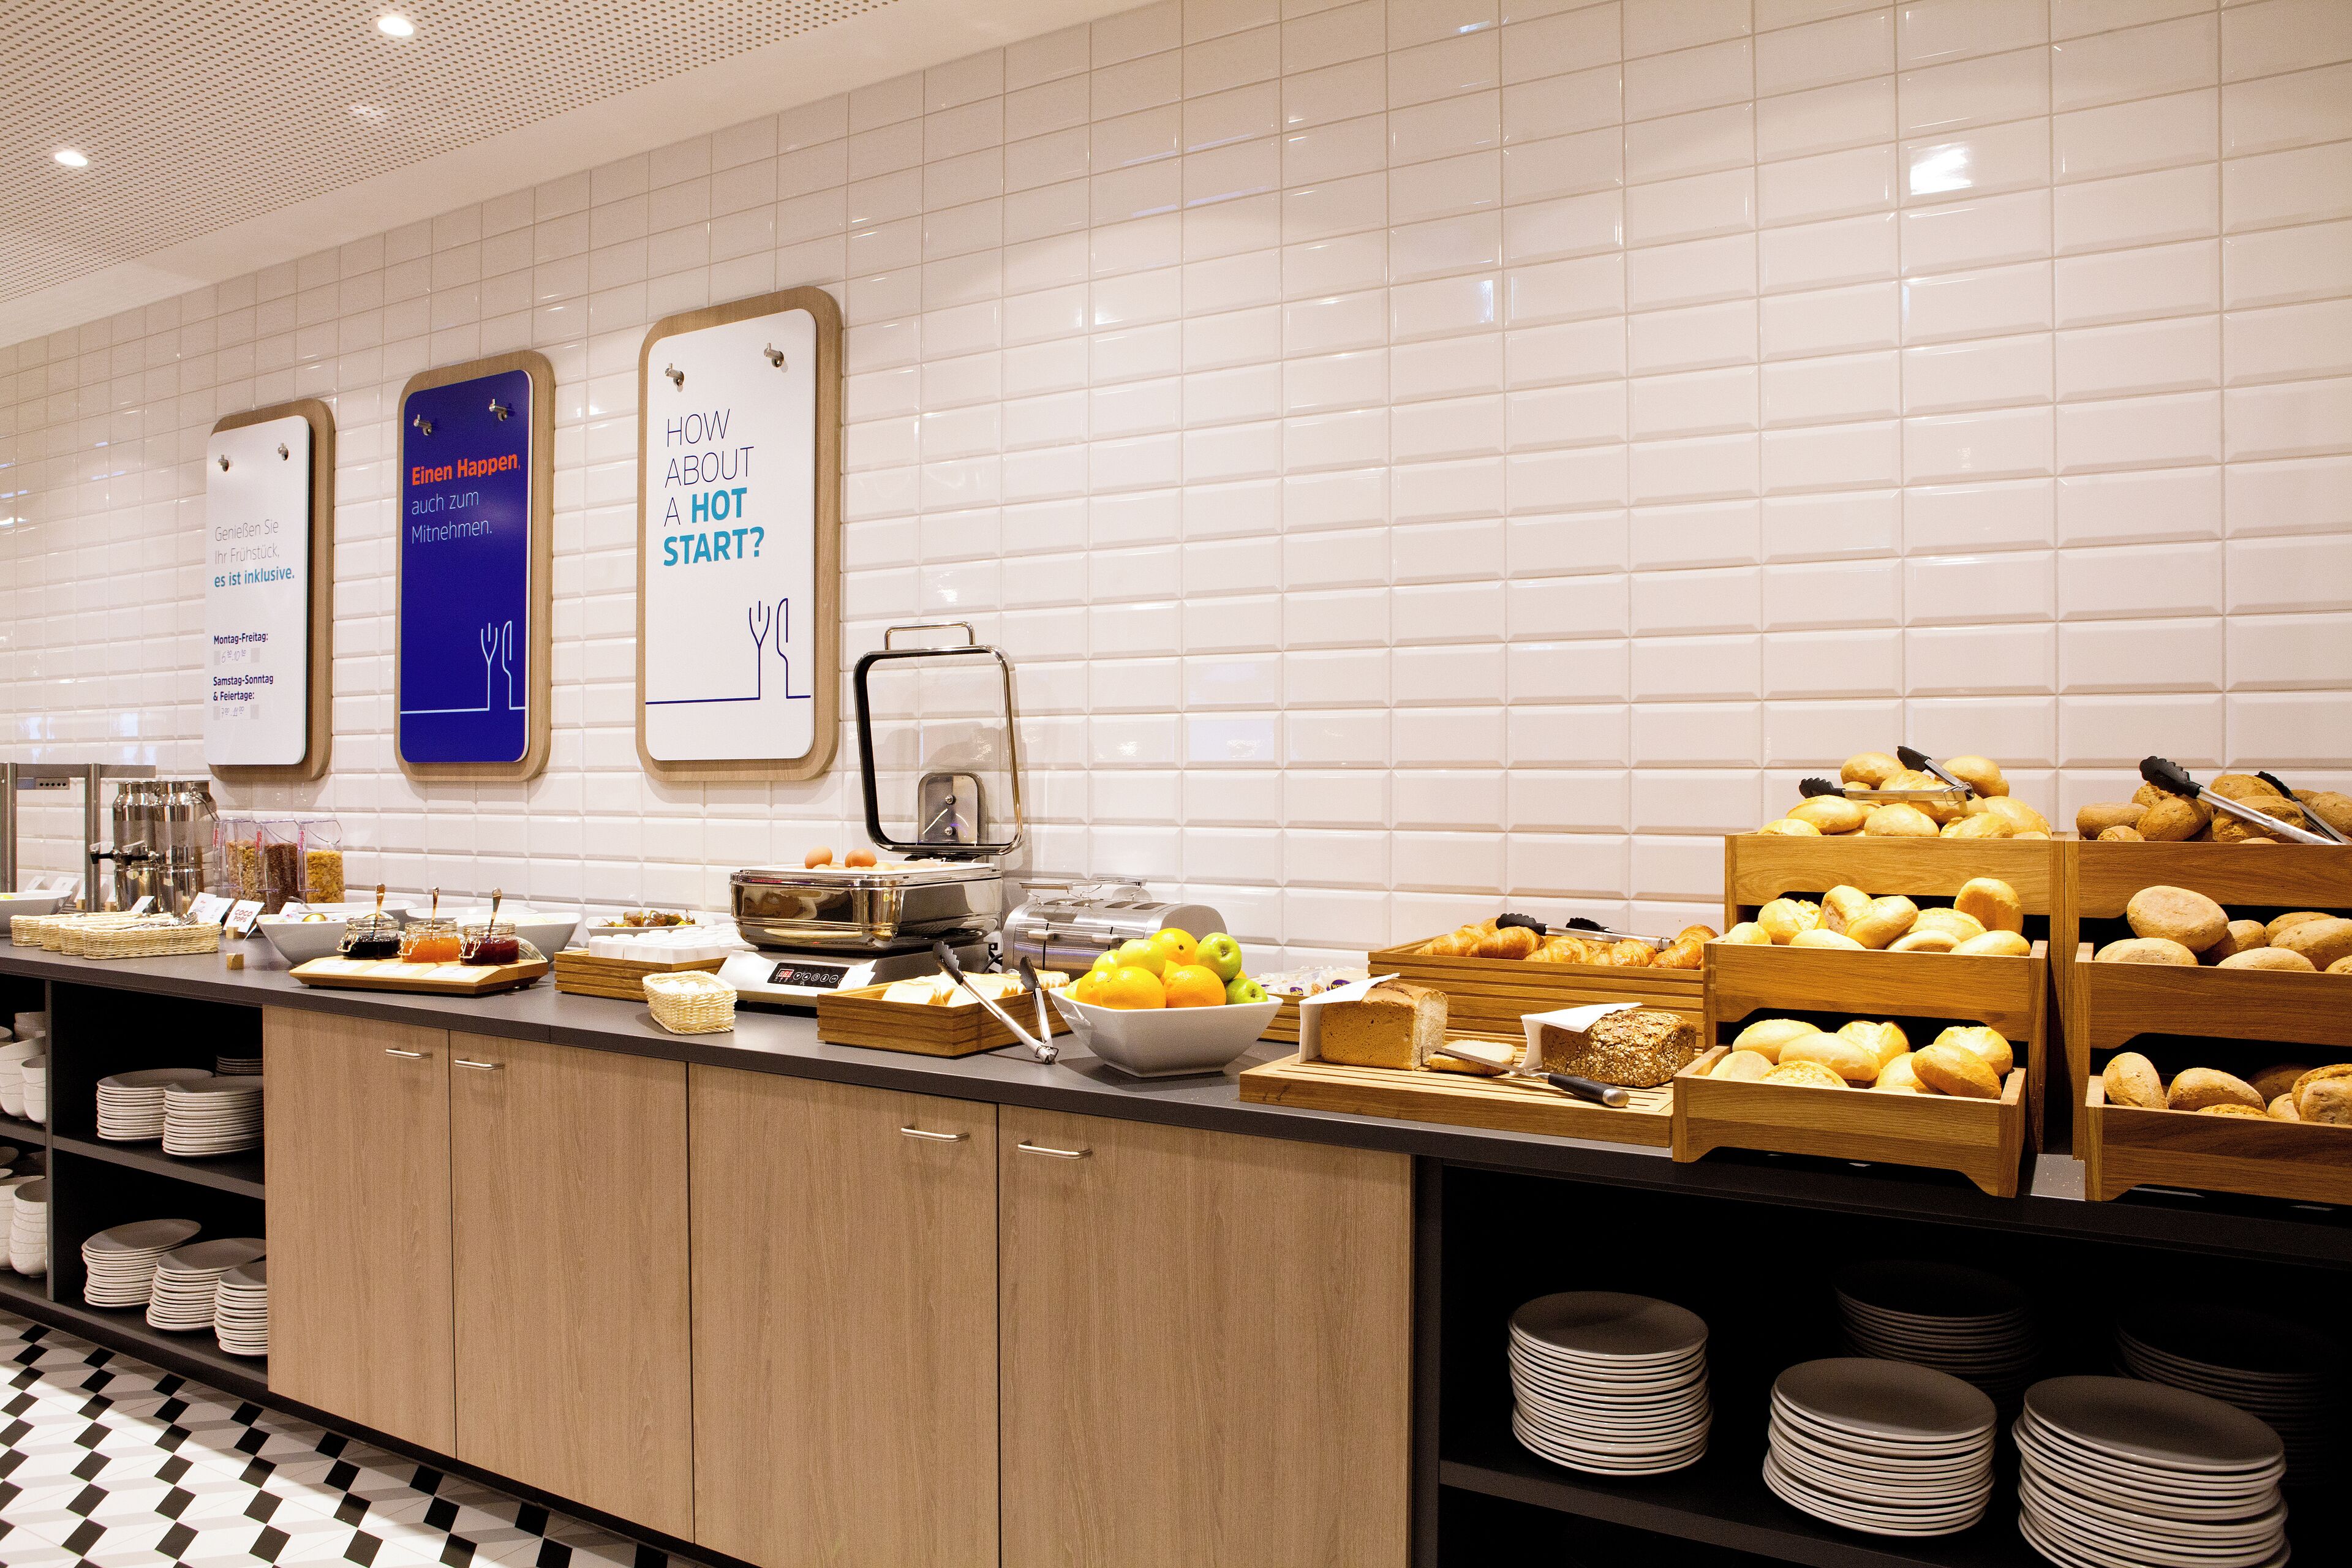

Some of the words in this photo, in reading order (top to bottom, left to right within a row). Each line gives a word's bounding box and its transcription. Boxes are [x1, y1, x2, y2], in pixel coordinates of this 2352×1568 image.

[667, 409, 730, 448] HOW
[412, 465, 453, 486] Einen
[665, 446, 755, 488] ABOUT
[412, 493, 445, 515] auch
[449, 491, 480, 510] zum
[664, 496, 681, 527] A
[692, 487, 748, 524] HOT
[215, 522, 262, 541] Genießen
[264, 519, 279, 535] Sie
[412, 519, 492, 544] Mitnehmen.
[215, 550, 228, 565] Ihr
[230, 543, 280, 563] Frühstück,
[663, 526, 765, 567] START?
[214, 575, 225, 588] es
[228, 571, 241, 586] ist
[244, 566, 295, 584] inklusive.
[214, 632, 269, 644] Montag-Freitag:
[213, 674, 274, 686] Samstag-Sonntag
[213, 691, 219, 701] &
[220, 691, 255, 702] Feiertage:
